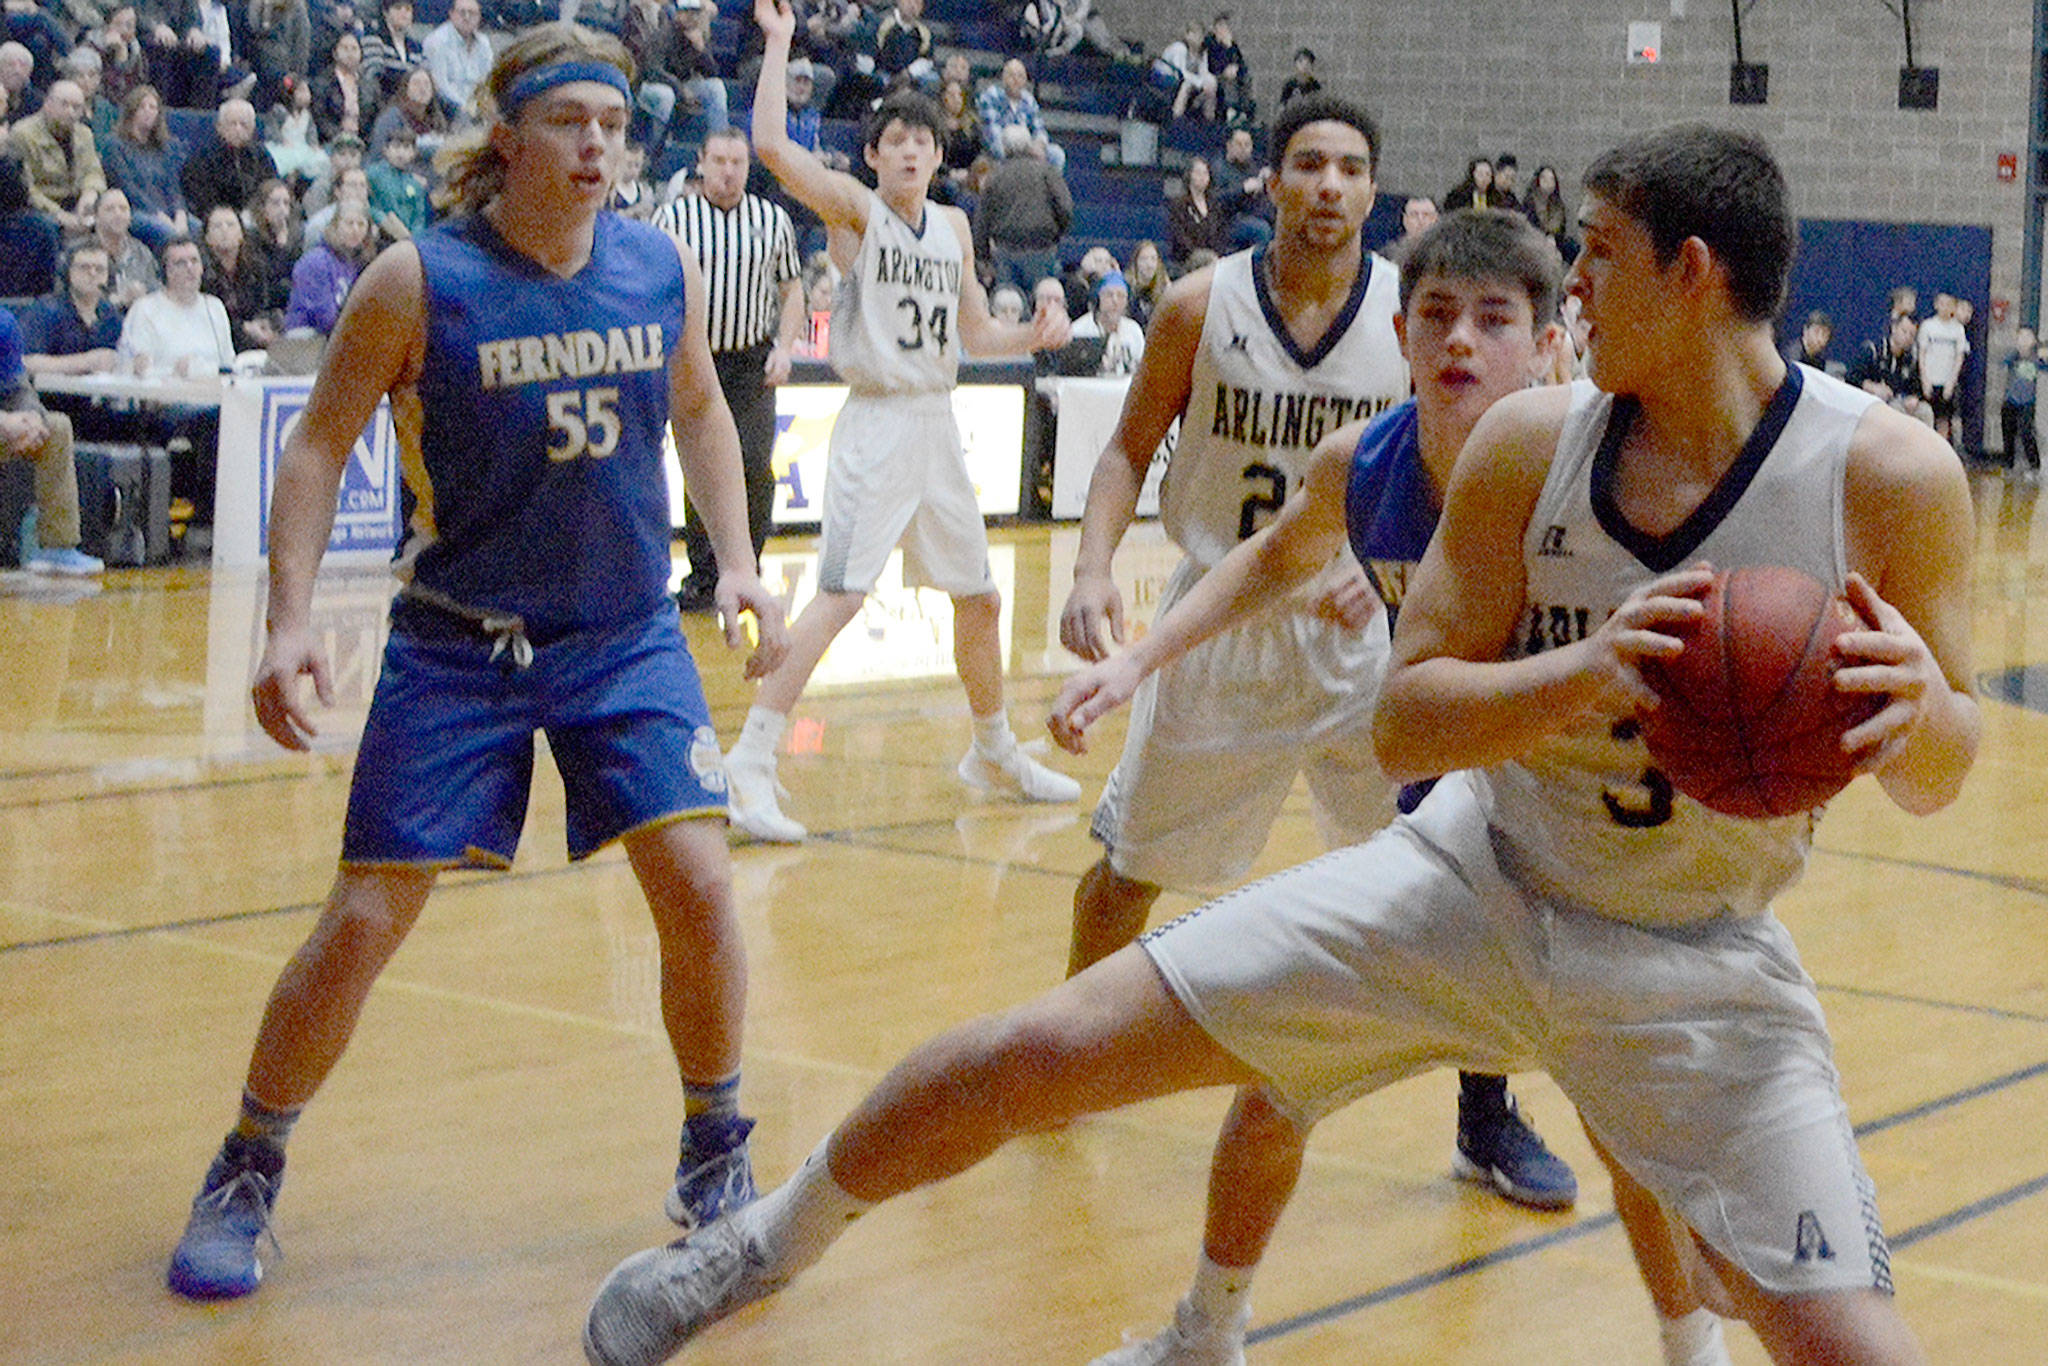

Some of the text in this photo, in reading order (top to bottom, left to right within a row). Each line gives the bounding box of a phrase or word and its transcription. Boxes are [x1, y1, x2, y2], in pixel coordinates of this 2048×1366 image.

[477, 322, 665, 392] FERNDALE
[897, 296, 948, 355] 34
[546, 386, 622, 462] 55
[1212, 381, 1391, 448] ARLINGT
